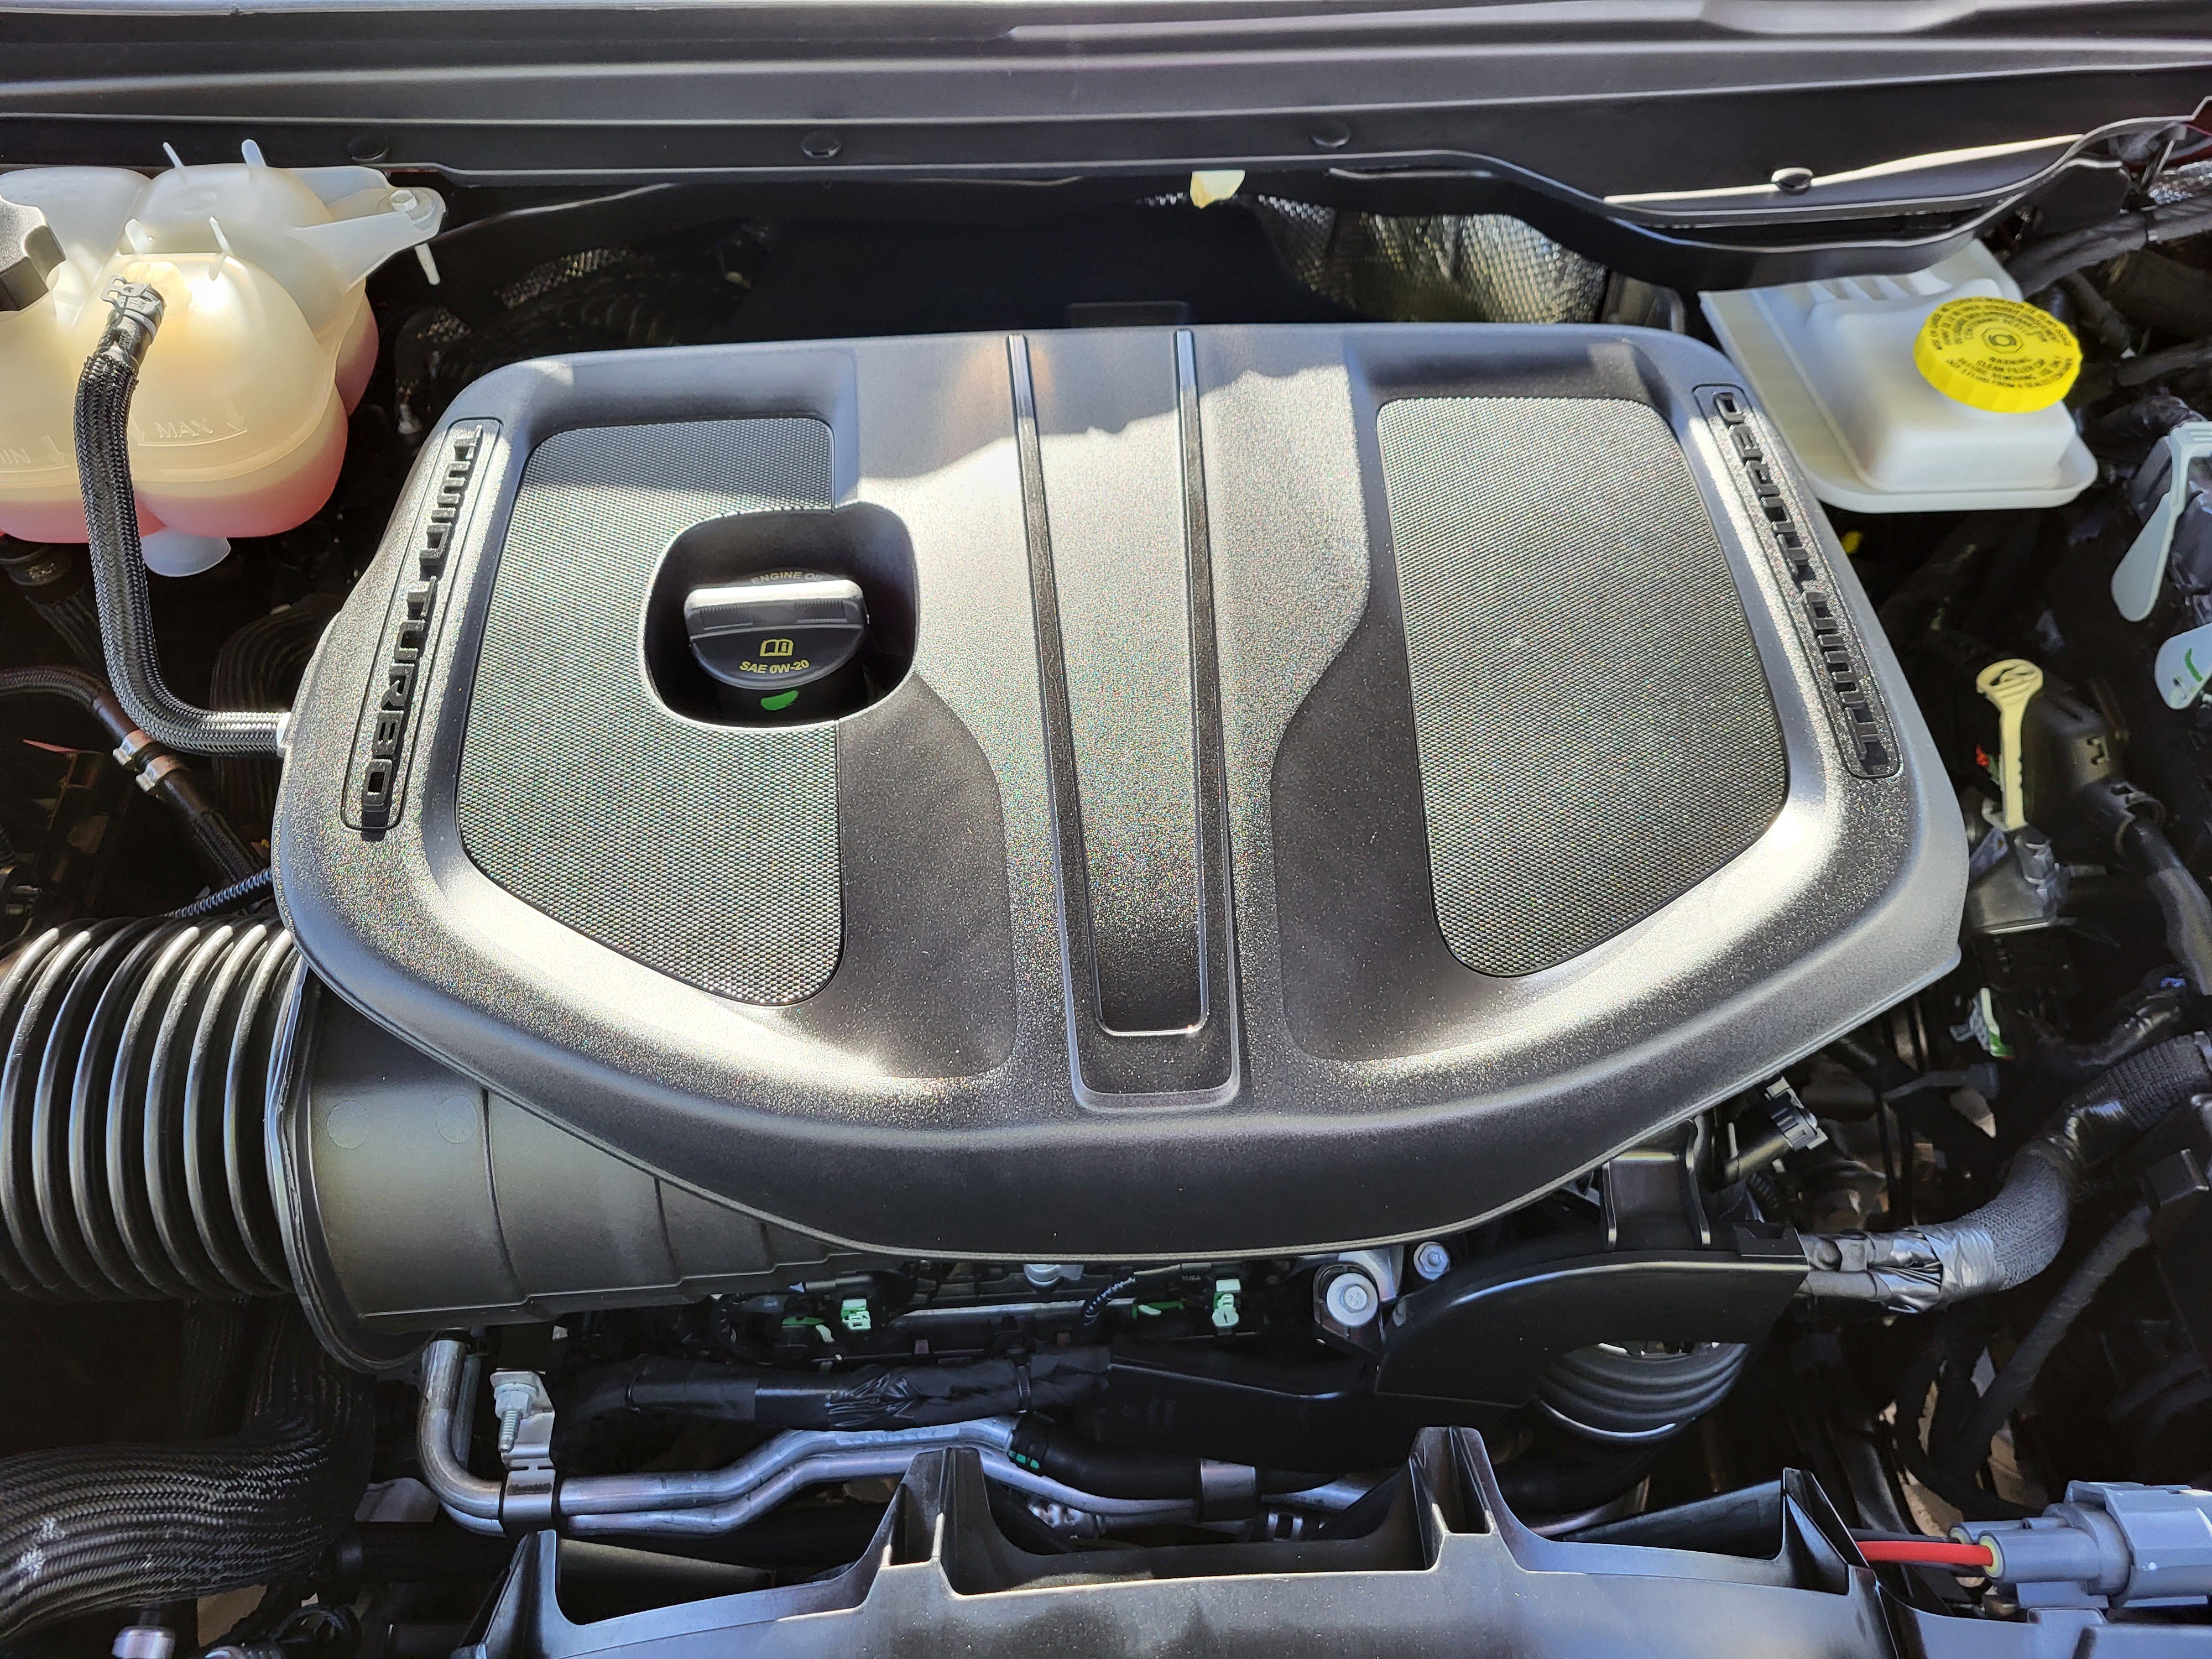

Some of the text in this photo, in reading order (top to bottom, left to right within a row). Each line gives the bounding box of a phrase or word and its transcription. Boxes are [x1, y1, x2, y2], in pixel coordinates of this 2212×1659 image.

[154, 417, 213, 439] MAX
[751, 571, 803, 585] ENGINE
[1714, 391, 1880, 762] TURBO TWIN
[361, 424, 483, 812] TWIN TURBO
[739, 659, 810, 674] SAE 0W-20
